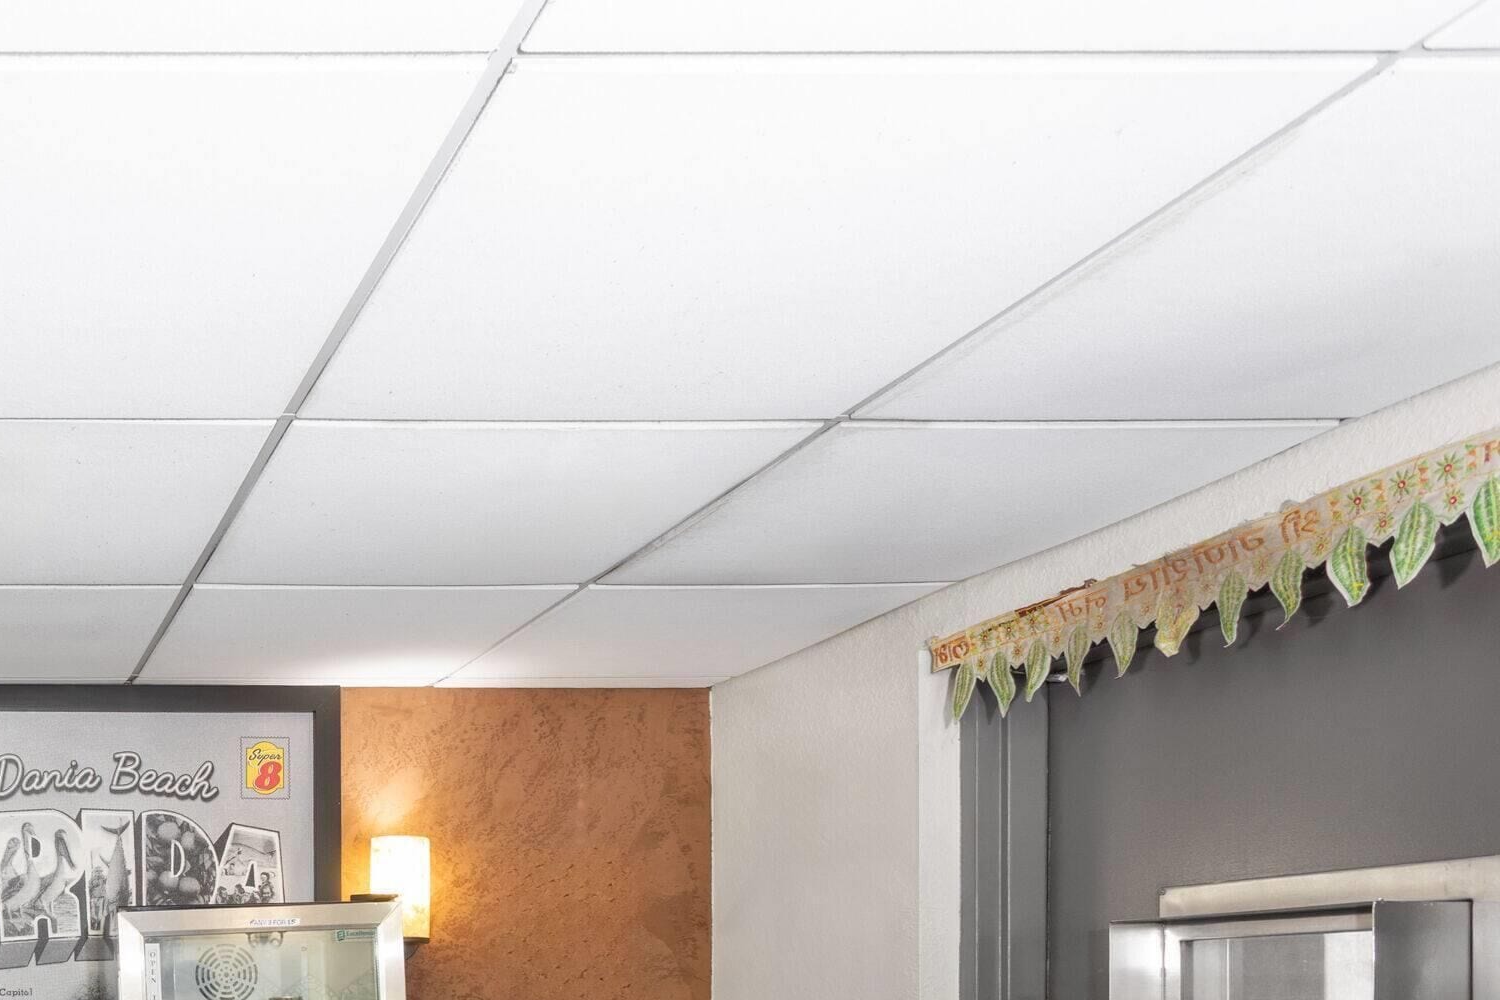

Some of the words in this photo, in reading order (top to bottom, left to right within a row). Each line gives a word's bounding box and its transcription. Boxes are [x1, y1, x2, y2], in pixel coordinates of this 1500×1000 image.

[247, 748, 283, 765] Super
[108, 750, 220, 801] Beach
[252, 761, 283, 791] 8
